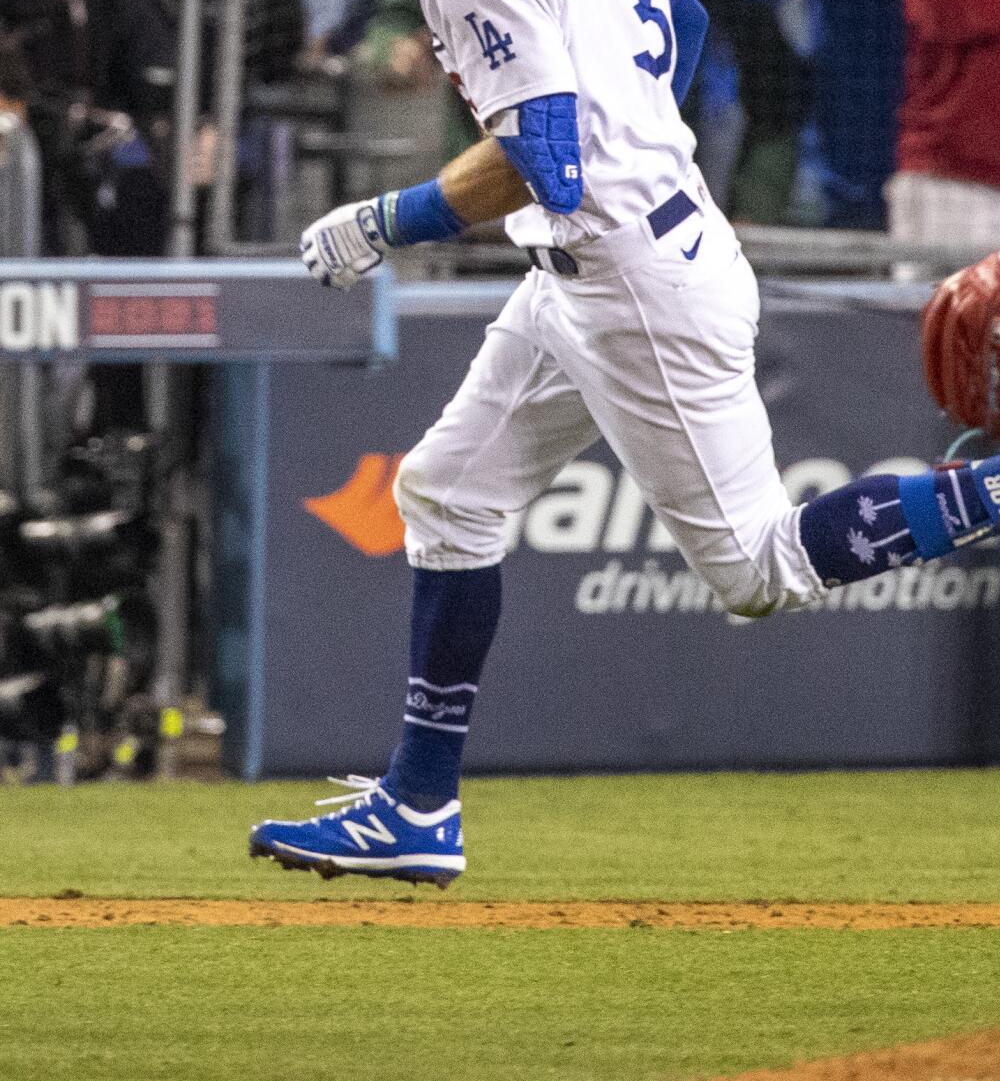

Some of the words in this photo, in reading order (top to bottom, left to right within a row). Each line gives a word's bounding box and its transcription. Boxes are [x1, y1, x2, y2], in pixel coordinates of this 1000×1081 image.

[464, 11, 516, 71] LA
[0, 281, 78, 352] ON
[341, 813, 397, 851] N
